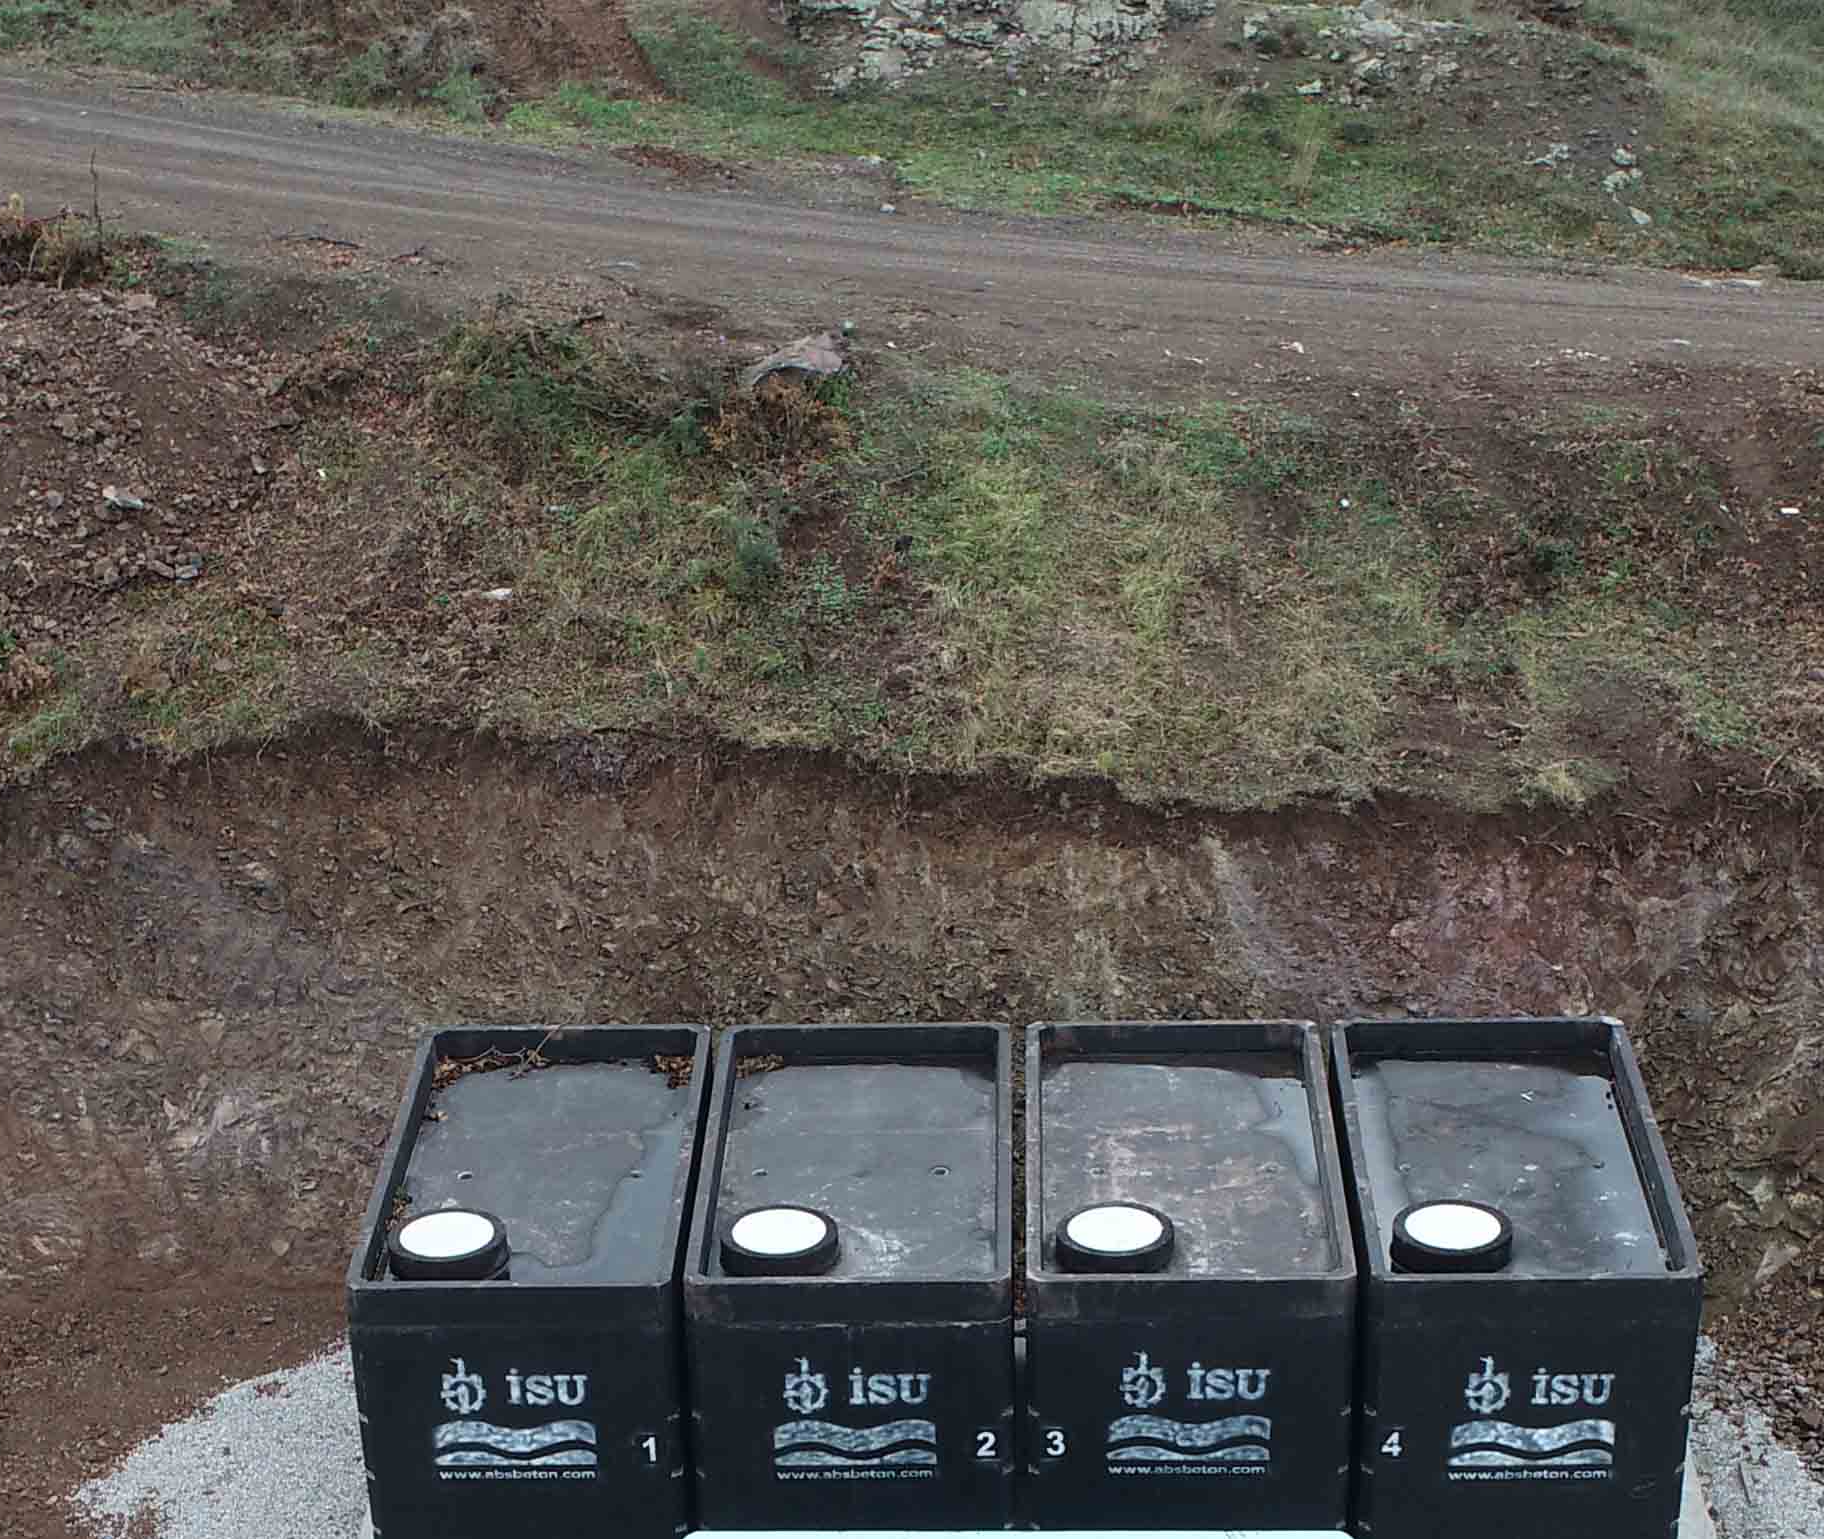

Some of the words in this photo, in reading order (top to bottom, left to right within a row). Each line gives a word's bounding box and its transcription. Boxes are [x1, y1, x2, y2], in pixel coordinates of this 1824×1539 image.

[641, 1436, 658, 1462] 1
[977, 1432, 996, 1457] 2
[1046, 1431, 1066, 1457] 3
[1381, 1432, 1402, 1458] 4
